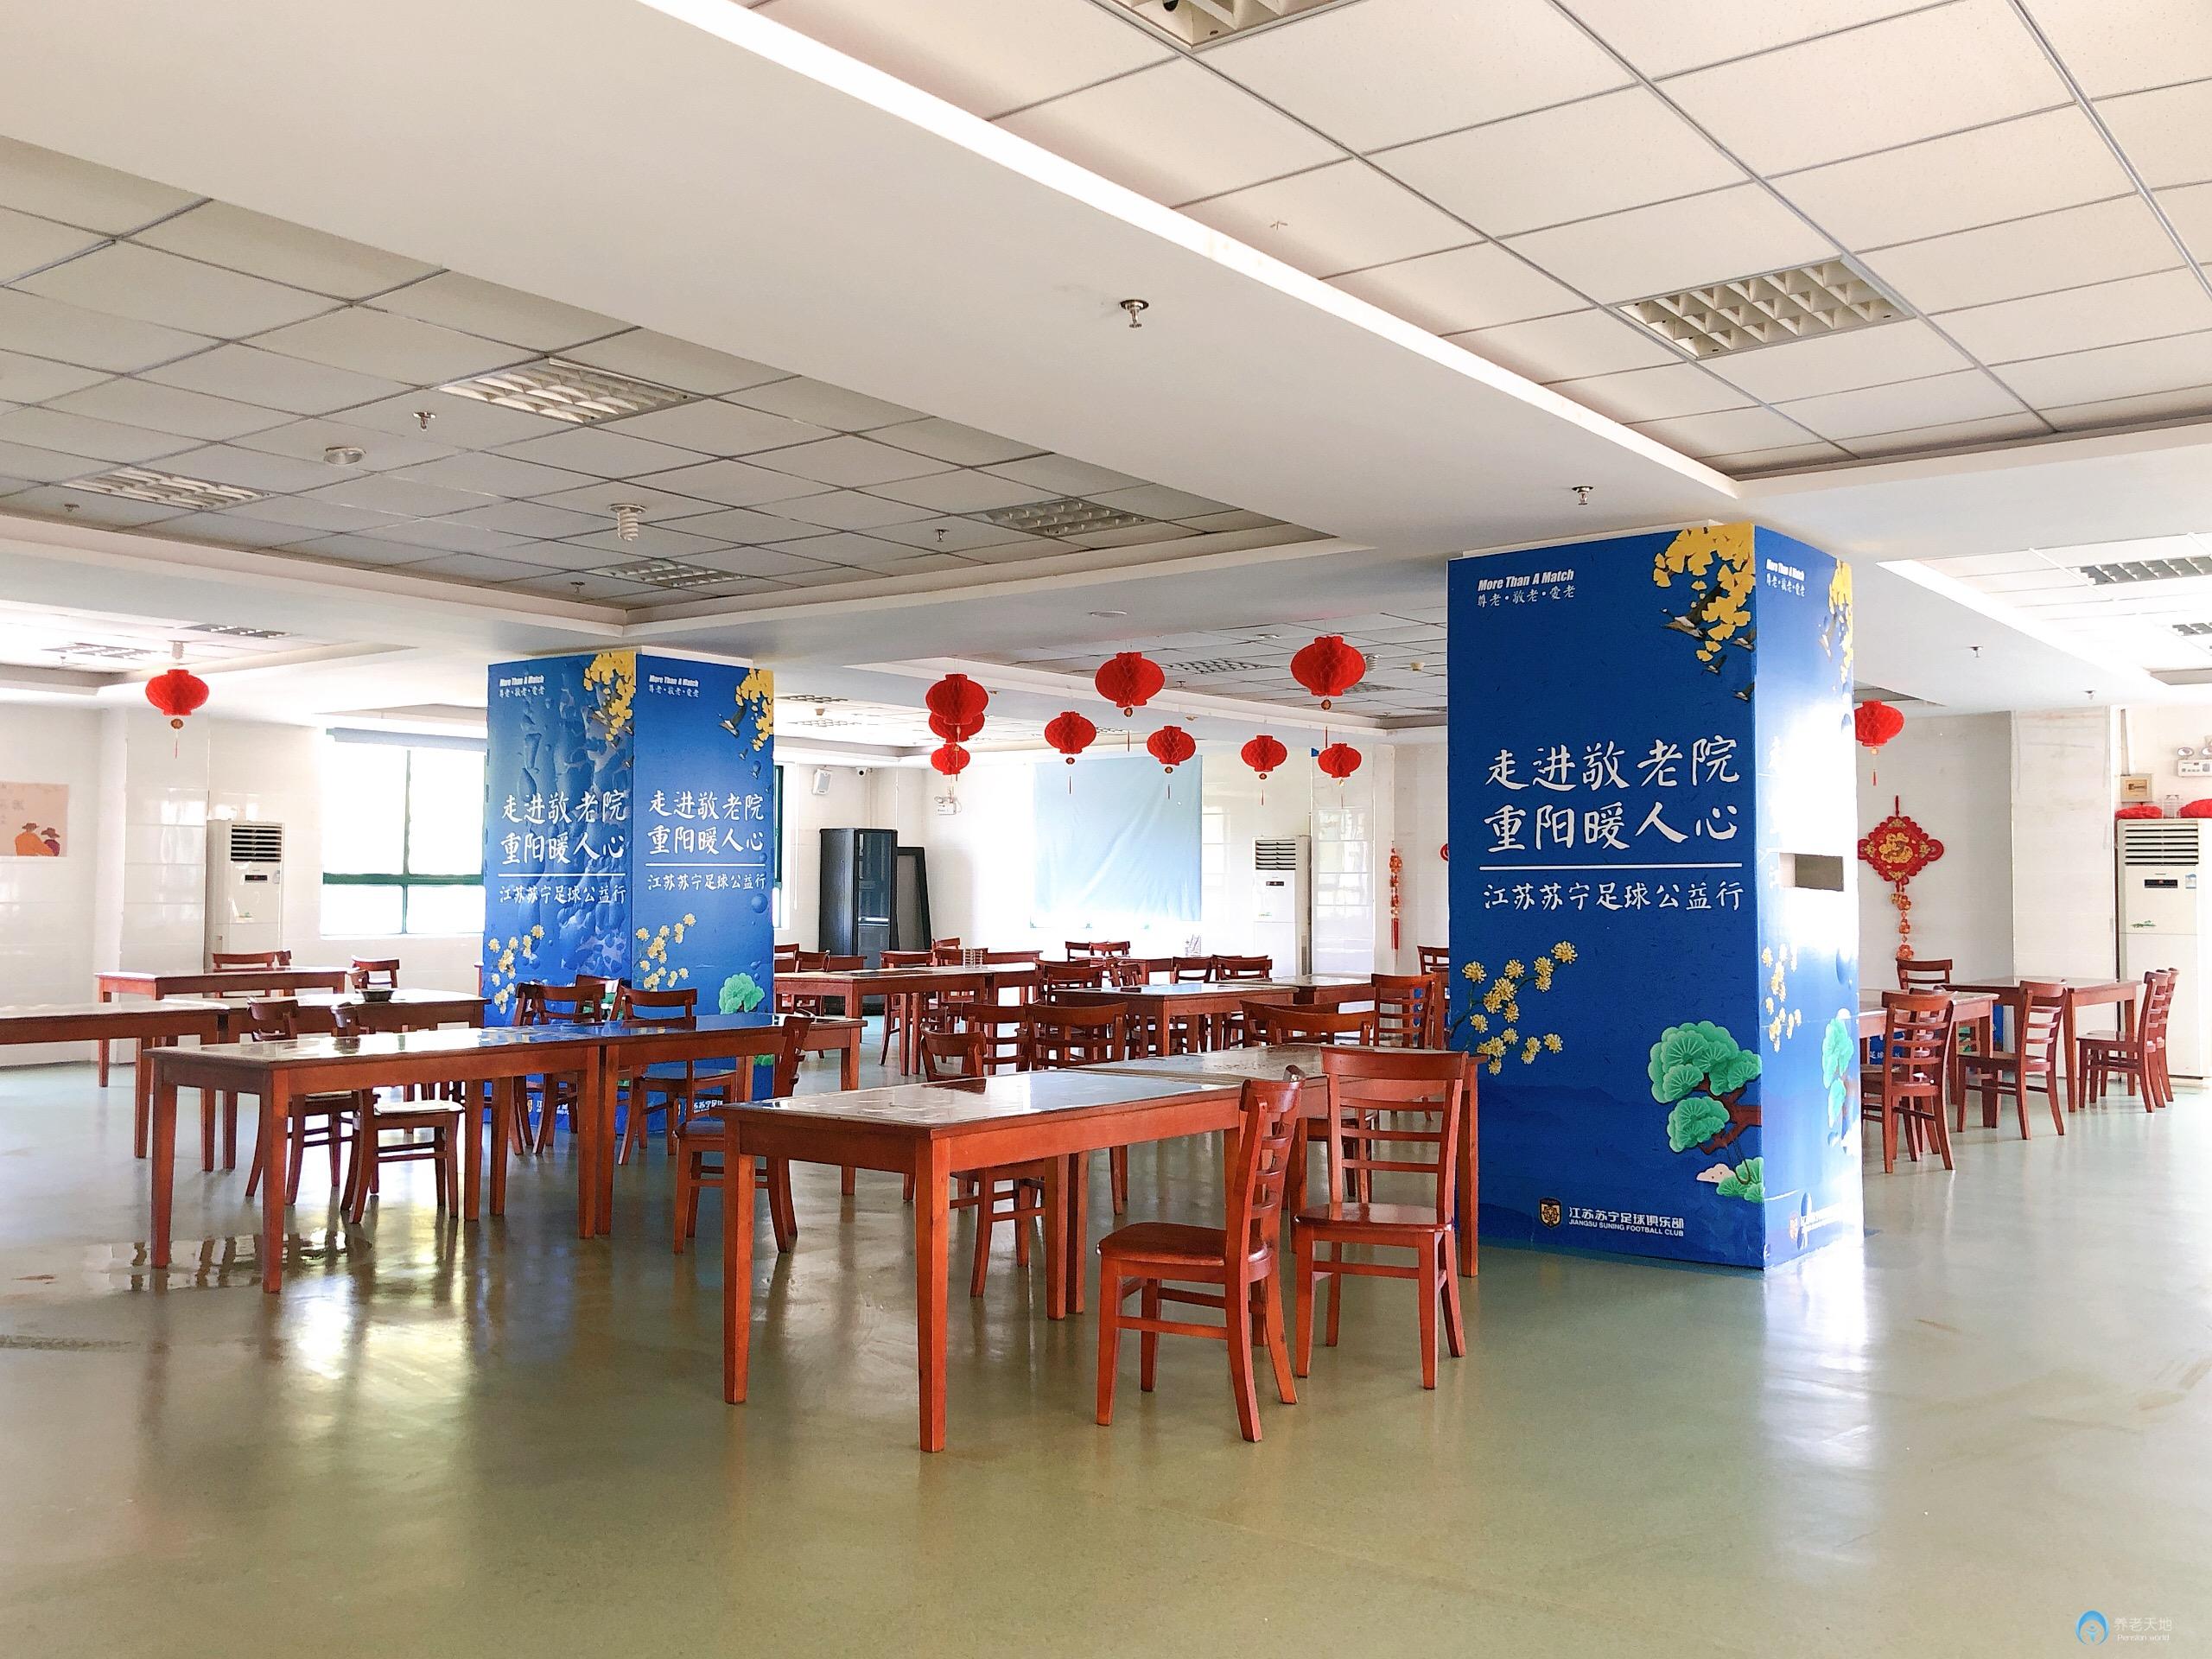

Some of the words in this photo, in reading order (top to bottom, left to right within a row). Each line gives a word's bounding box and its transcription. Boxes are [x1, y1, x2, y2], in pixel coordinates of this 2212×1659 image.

[1478, 579, 1503, 592] More
[1505, 575, 1530, 588] Than
[1532, 573, 1540, 585] A
[1541, 569, 1574, 584] Match
[1485, 734, 1740, 791] 走进敬老院
[501, 789, 628, 825] 走进敬老院
[648, 789, 765, 822] 走进敬老院
[647, 824, 764, 855] 重阳暖人心
[1484, 801, 1738, 853] 重阳暖人心
[500, 830, 625, 865] 重阳暖人心
[499, 882, 626, 905] 江苏苏宁足球公益行
[647, 872, 767, 891] 江苏苏宁足球公益行
[1483, 880, 1744, 911] 江苏苏宁足球公益行
[1568, 1206, 1684, 1230] 江苏苏宁足球俱乐部
[1568, 1219, 1598, 1228] JIANGSU
[1599, 1222, 1625, 1231] SUNING
[1625, 1224, 1663, 1236] FOOTBALL
[1664, 1228, 1684, 1237] CLUB
